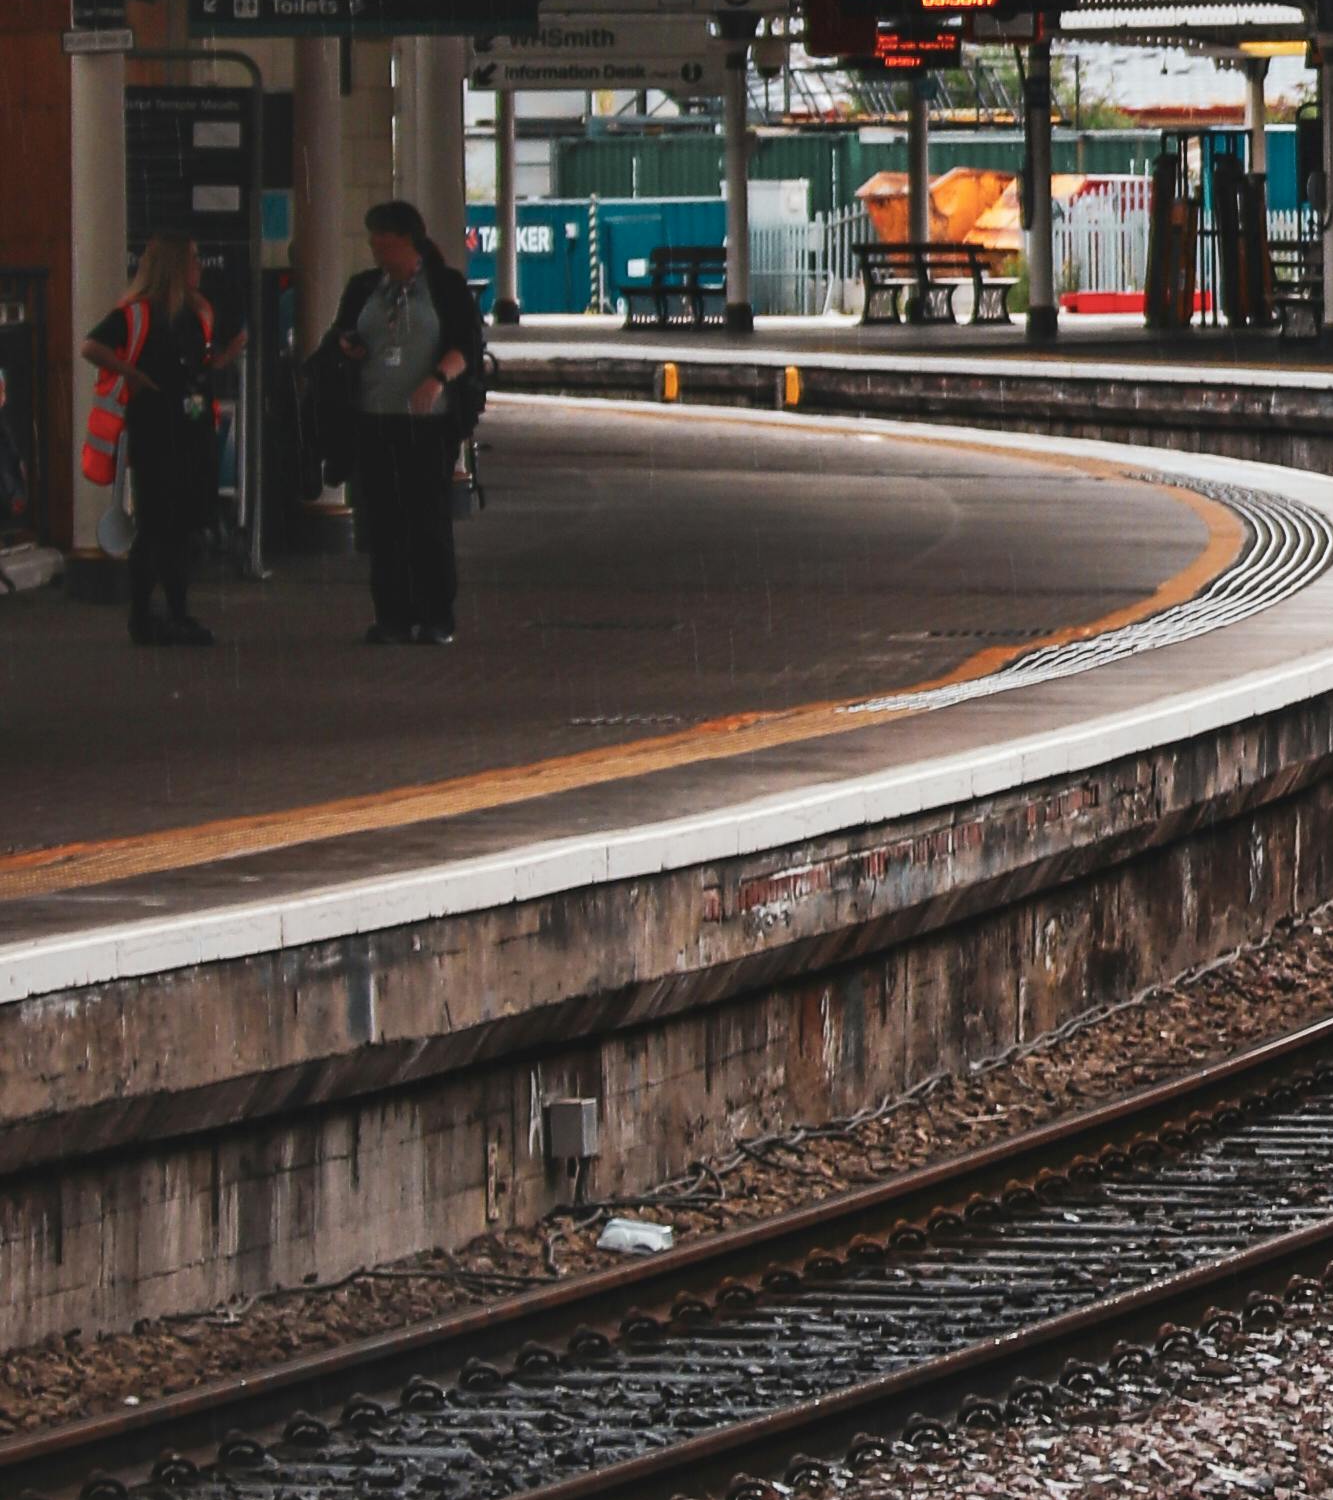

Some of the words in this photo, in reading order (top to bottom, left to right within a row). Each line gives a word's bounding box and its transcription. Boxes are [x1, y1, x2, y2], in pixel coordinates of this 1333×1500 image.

[505, 65, 600, 79] Information
[604, 65, 645, 78] Desk
[479, 226, 553, 252] TAKER
